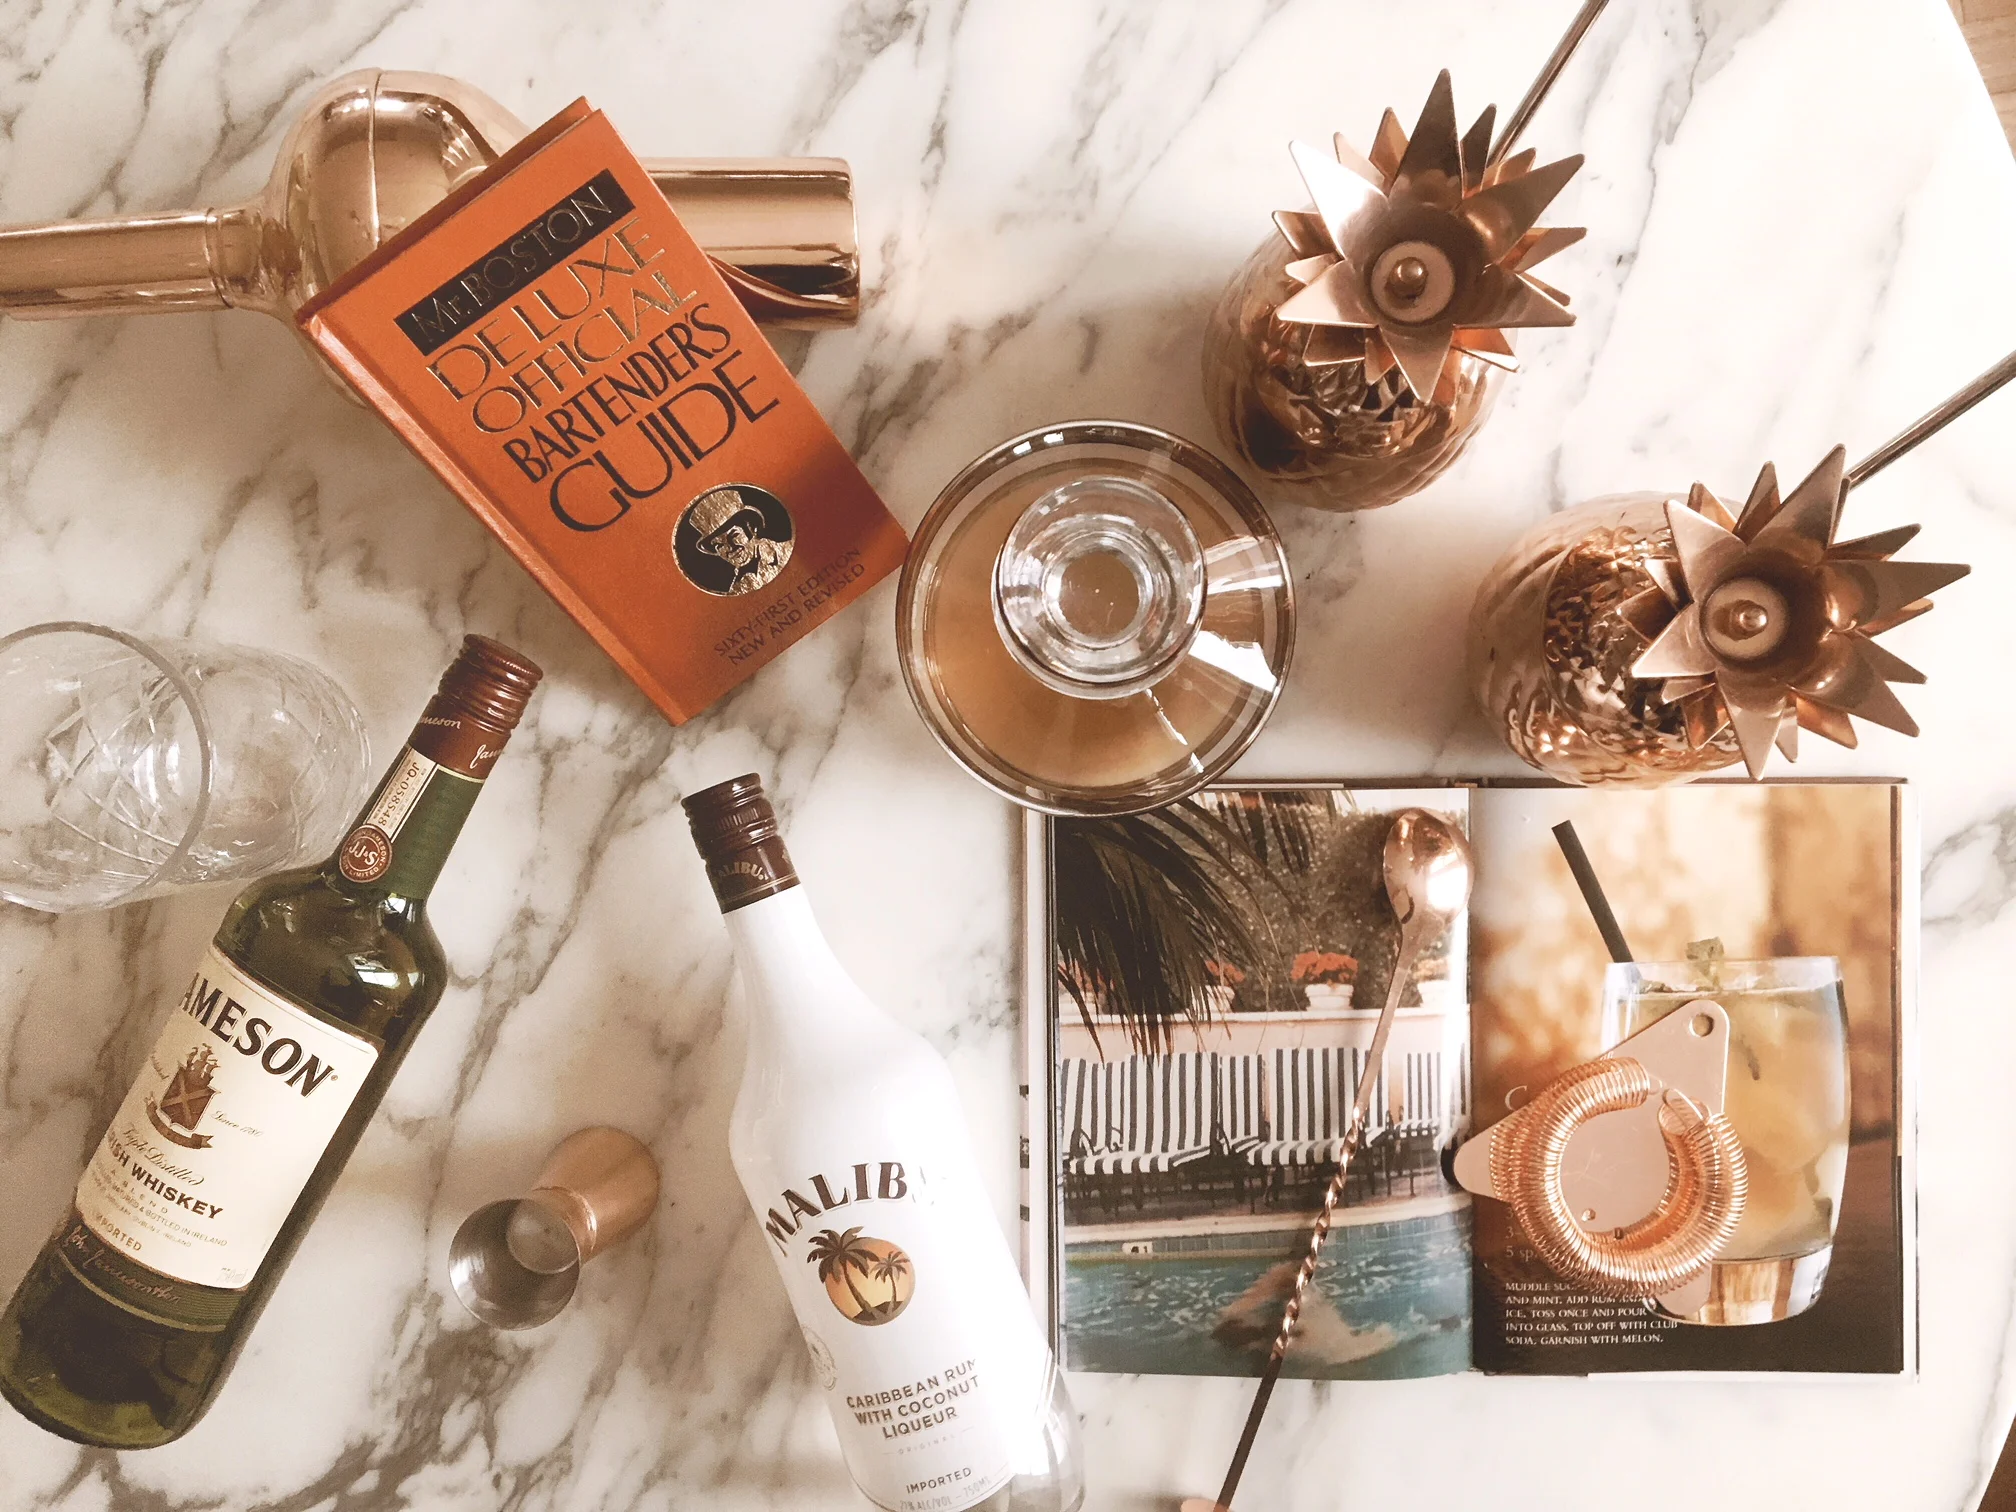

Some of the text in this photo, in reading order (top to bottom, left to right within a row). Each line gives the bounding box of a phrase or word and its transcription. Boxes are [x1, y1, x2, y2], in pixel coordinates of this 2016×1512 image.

[411, 186, 612, 342] Mr. BOSTON
[472, 270, 697, 433] OFFICIAL
[502, 303, 731, 484] BARTENDER'S
[550, 349, 781, 532] GUIDE
[714, 548, 862, 657] SIXTY-FIRST EDITION
[728, 563, 865, 666] NEW AND REVISED
[378, 762, 420, 827] JQ-058548
[714, 861, 764, 880] ALIBU
[178, 971, 336, 1098] AMESON
[131, 1161, 224, 1220] WHISKEY
[765, 1161, 936, 1258] MALIB
[1506, 1245, 1514, 1258] 5
[1505, 1282, 1551, 1291] MUDDLE
[1505, 1295, 1530, 1304] AND
[1566, 1295, 1589, 1304] ADD
[1531, 1309, 1556, 1318] TOSS
[1558, 1308, 1589, 1318] ONCE
[1591, 1308, 1615, 1317] AND
[1617, 1307, 1648, 1317] POUR
[1505, 1322, 1534, 1332] INTO
[1572, 1322, 1595, 1332] TOP
[1596, 1321, 1617, 1331] OFF
[1619, 1320, 1647, 1330] WITH
[1650, 1319, 1678, 1329] CLUB
[1540, 1335, 1588, 1345] GARNISH
[1590, 1335, 1619, 1344] WITH
[846, 1375, 940, 1409] CARIBBEAN
[854, 1374, 980, 1426] WITH COCONUT
[882, 1405, 958, 1440] LIQUEUR
[905, 1467, 972, 1494] IMPORTED
